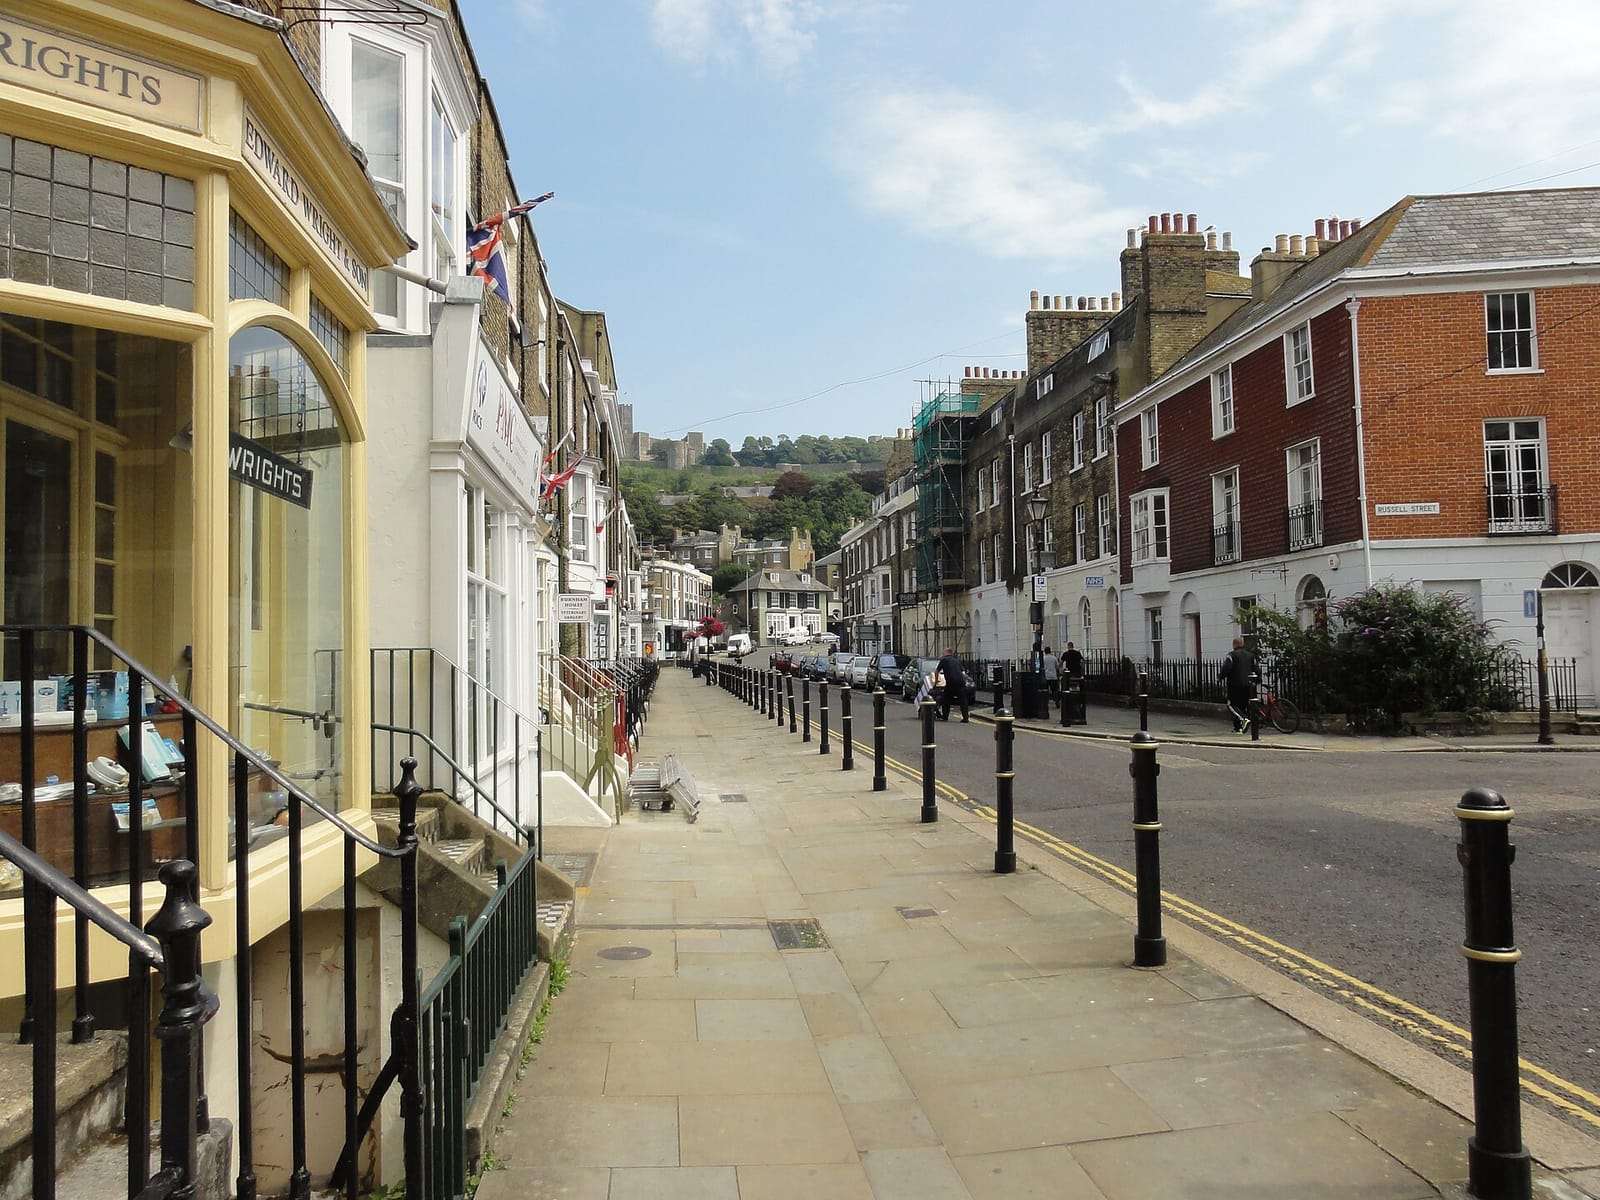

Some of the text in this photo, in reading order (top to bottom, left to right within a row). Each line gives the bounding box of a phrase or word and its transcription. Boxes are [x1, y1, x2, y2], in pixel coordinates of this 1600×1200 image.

[245, 117, 368, 293] EDWARD WRIGHT & SON
[229, 446, 302, 498] WRIGHTS
[1377, 504, 1436, 513] RUSSELL STREET
[1086, 577, 1103, 585] NHS
